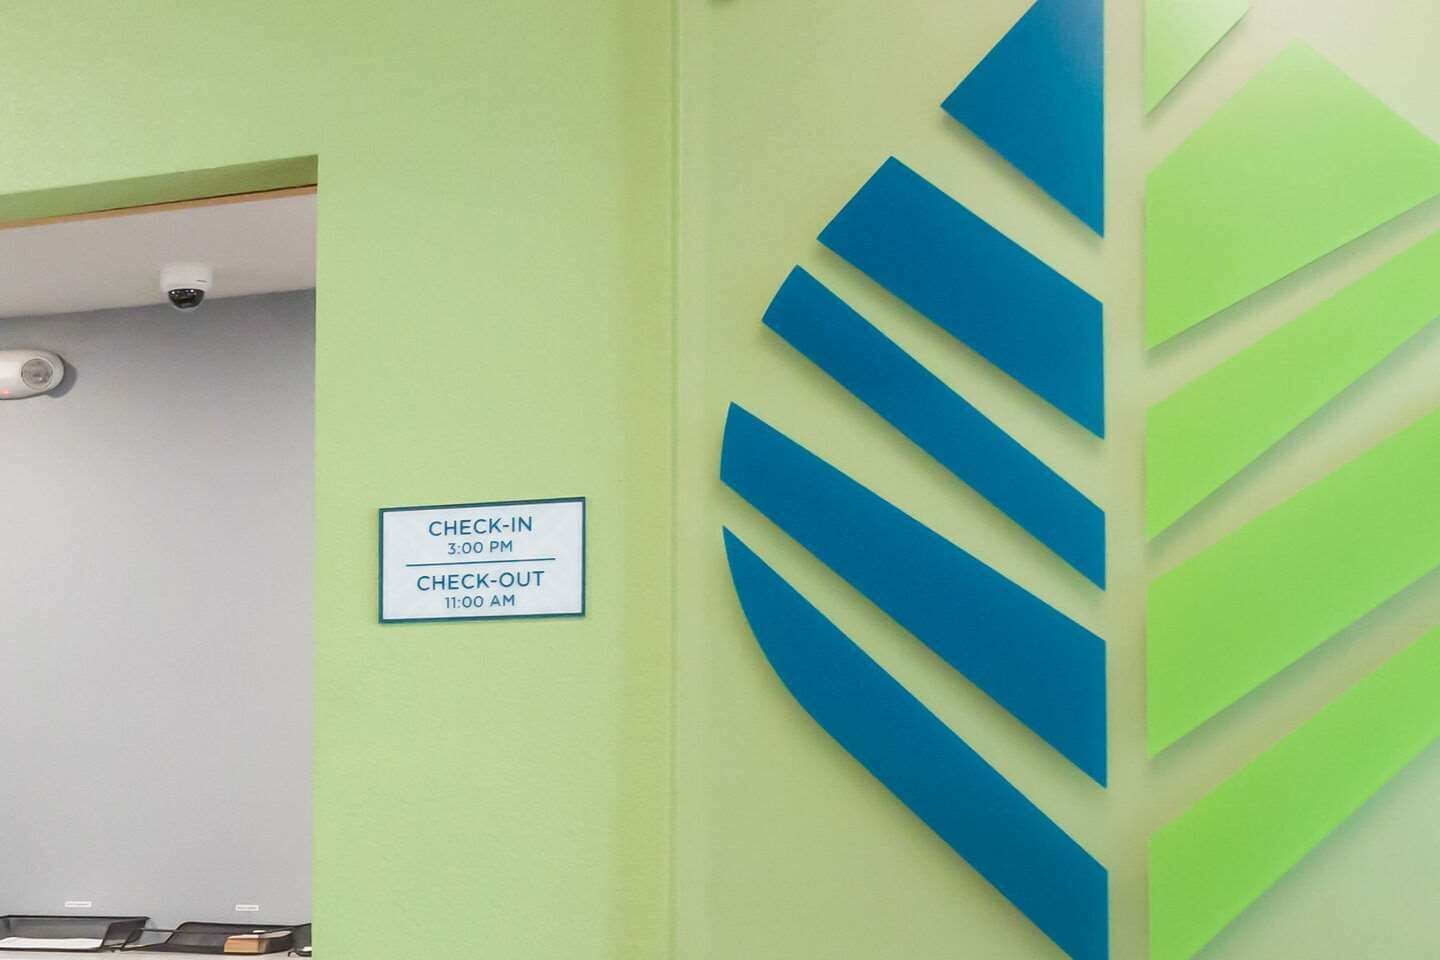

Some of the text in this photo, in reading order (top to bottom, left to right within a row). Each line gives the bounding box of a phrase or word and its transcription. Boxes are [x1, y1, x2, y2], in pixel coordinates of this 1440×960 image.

[428, 516, 533, 537] CHECK-IN
[447, 540, 513, 555] 3:00 PM
[416, 570, 545, 591] CHECK-OUT
[445, 594, 515, 609] 11:00 AM
